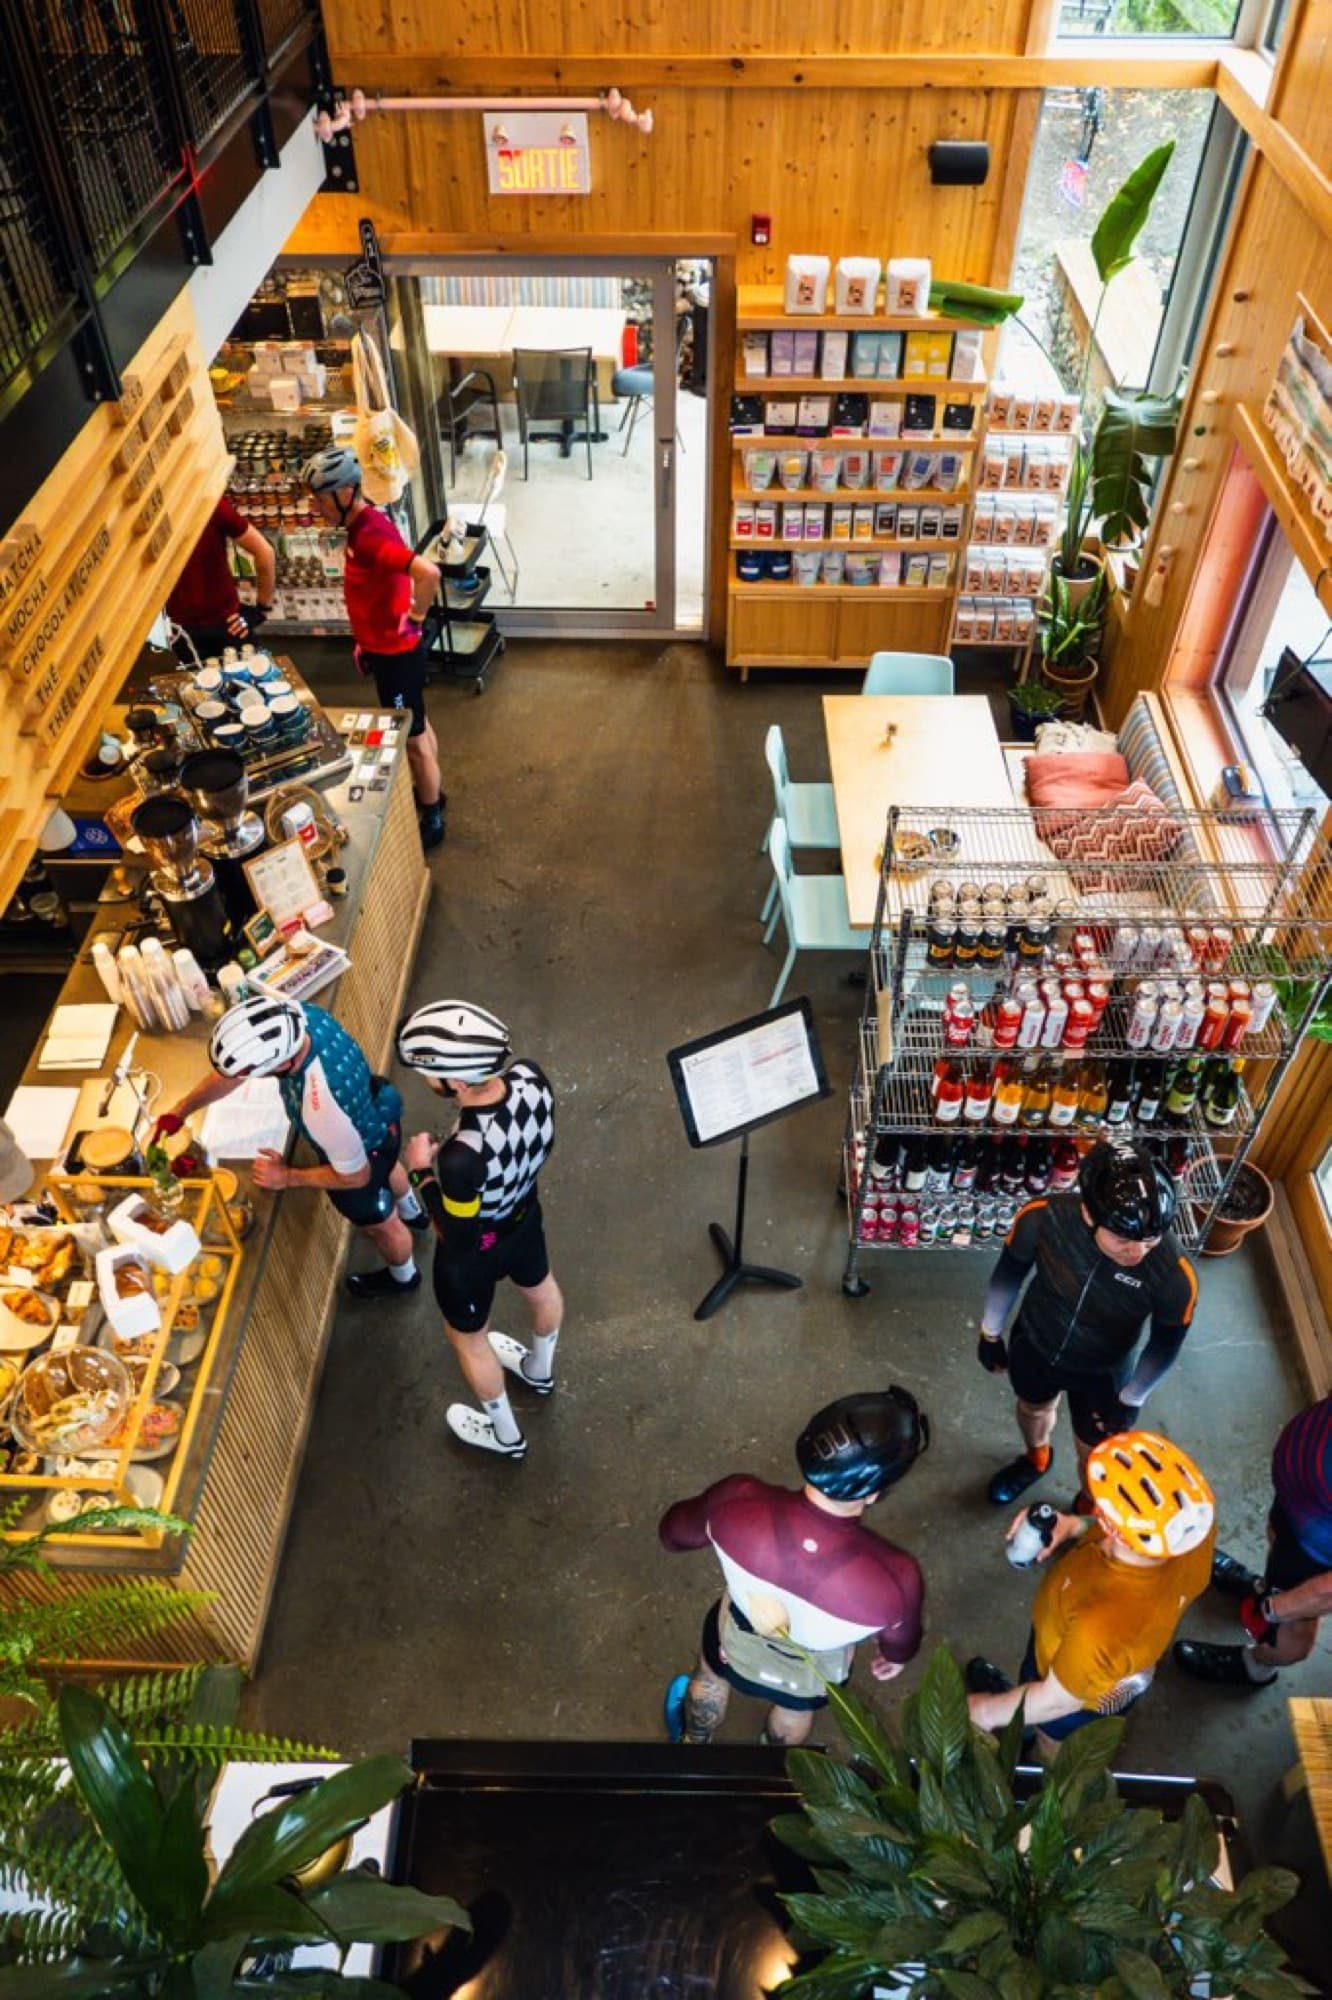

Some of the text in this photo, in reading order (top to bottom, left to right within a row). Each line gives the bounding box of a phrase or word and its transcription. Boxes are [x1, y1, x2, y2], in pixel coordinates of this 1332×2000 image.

[497, 148, 580, 189] SORTIE
[8, 578, 47, 641] MOCHA
[23, 581, 78, 675] CHOCOLAT
